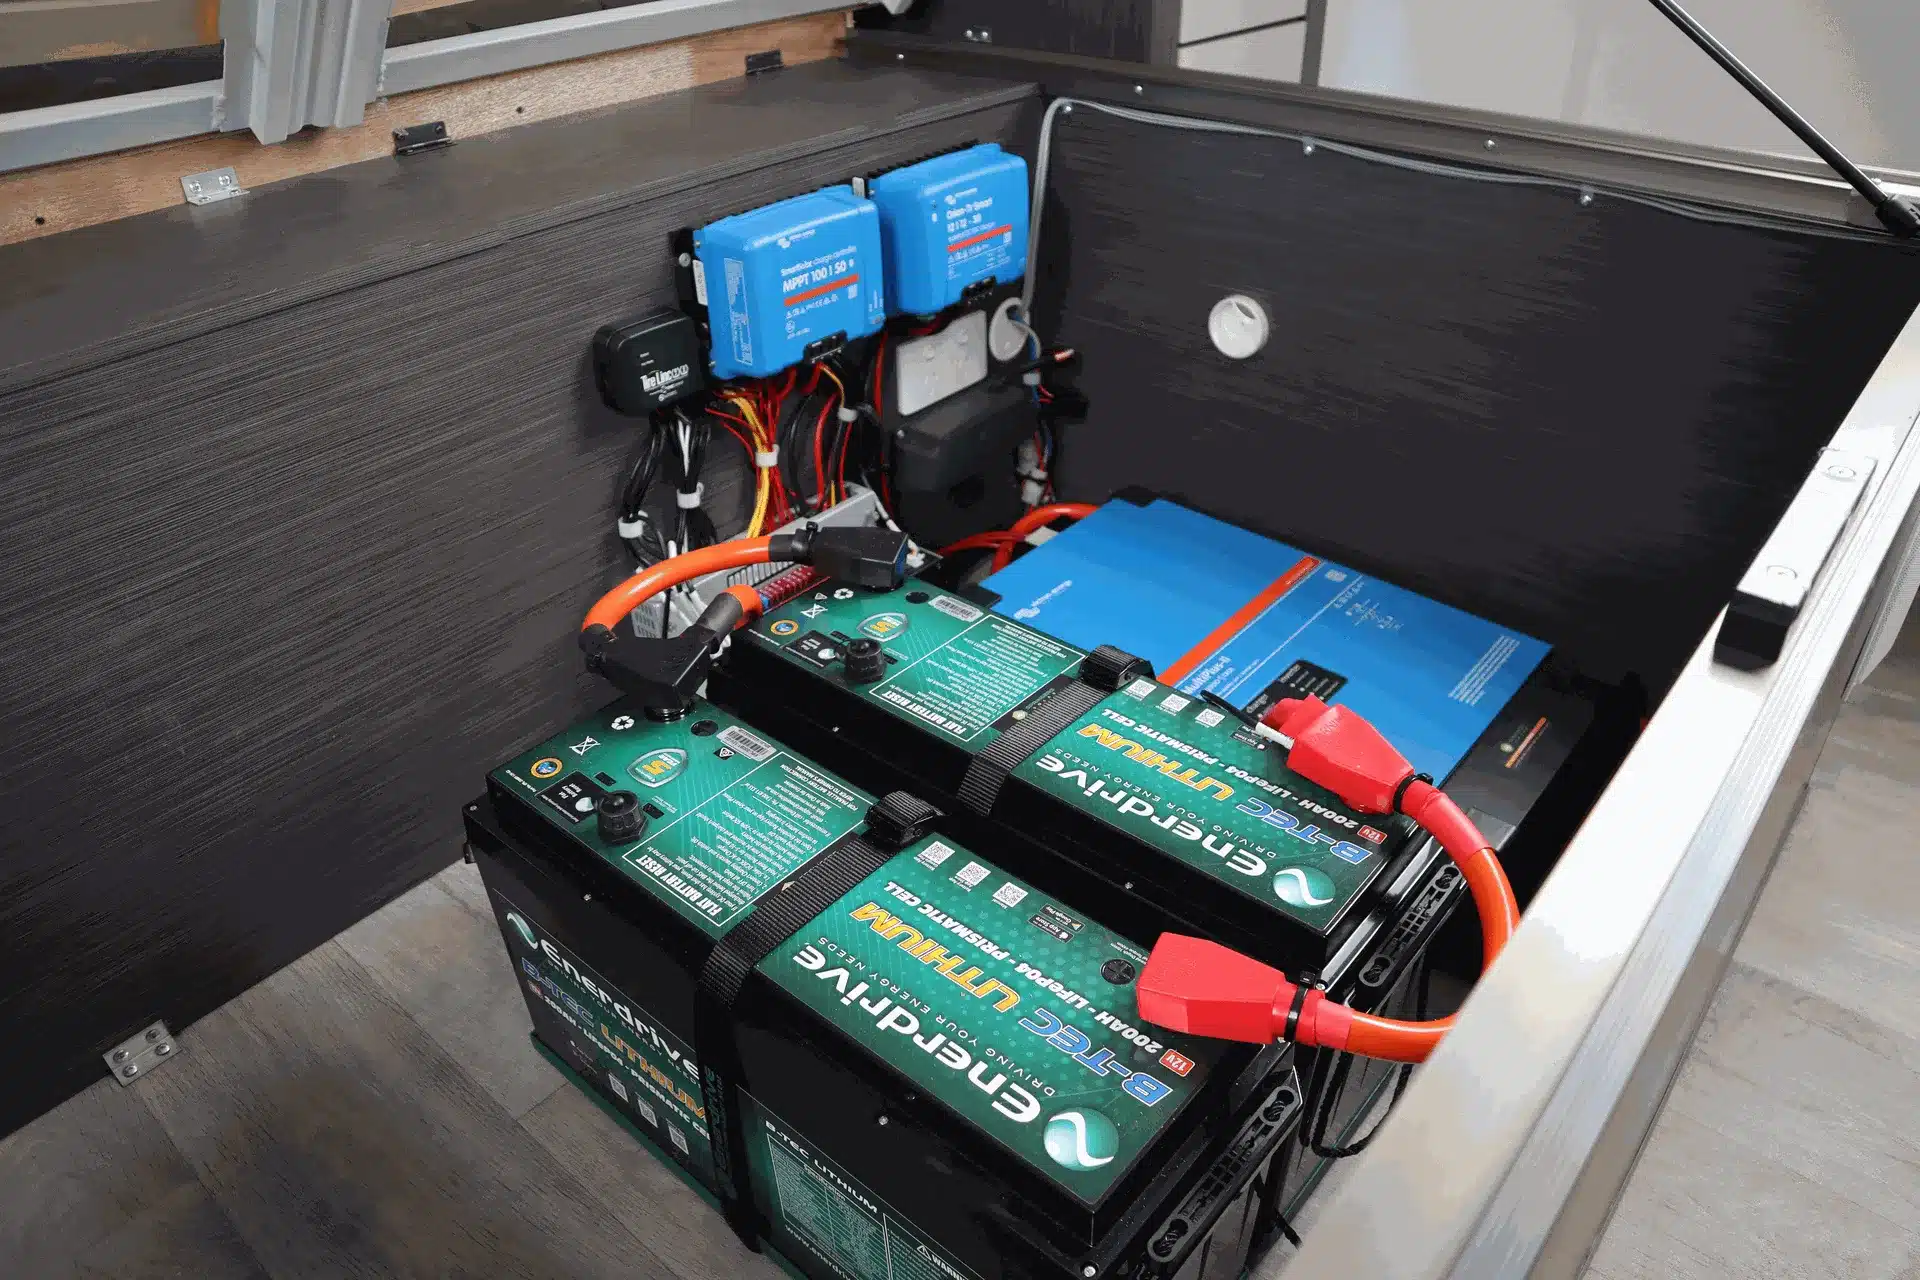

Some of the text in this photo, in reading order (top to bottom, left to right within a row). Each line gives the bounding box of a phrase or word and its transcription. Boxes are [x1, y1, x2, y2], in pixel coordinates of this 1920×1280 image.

[782, 259, 846, 293] MPPT 100 50
[881, 690, 966, 734] FLAT BATTERY RESET
[1102, 708, 1135, 726] CELL
[1134, 724, 1217, 764] PRISMATIC
[1078, 723, 1233, 799] LITHIUM
[1038, 755, 1265, 875] Enerdrive
[1054, 748, 1276, 858] DRIVING YOUR ENERGY NEEDS
[1236, 797, 1371, 864] B-TEC
[1298, 799, 1357, 827] 200AH
[635, 854, 722, 915] FLAT BATTERY RESET
[884, 881, 920, 906] CELL
[918, 904, 1009, 959] PRISMATIC
[521, 956, 595, 1028] B-TEC
[540, 939, 699, 1080] Enerdrive
[818, 936, 1055, 1096] DRIVING YOUR ENERGY NEEDS
[851, 902, 1172, 1106] B-TEC LITHIUM
[544, 995, 577, 1029] 200AH
[630, 1068, 692, 1123] PRISMATIC
[794, 946, 1039, 1121] Enerdrive
[1094, 1011, 1162, 1052] 200AH
[765, 1120, 810, 1160] B-TEC
[814, 1158, 878, 1214] LITHIUM
